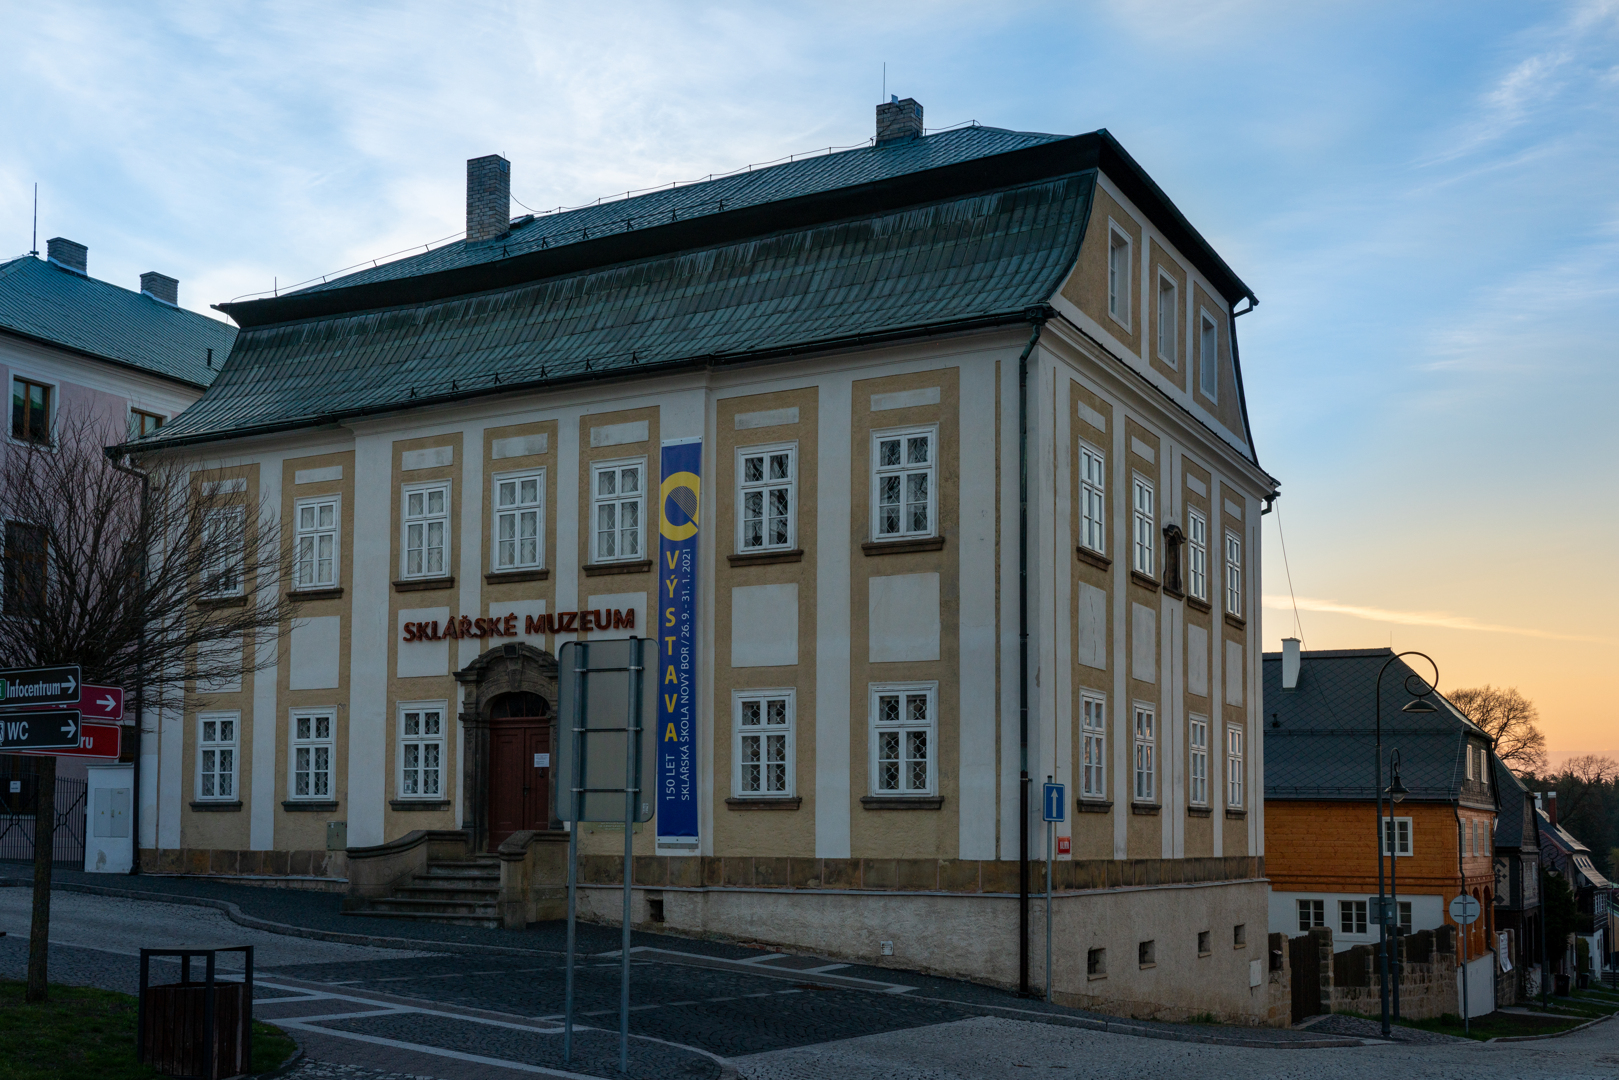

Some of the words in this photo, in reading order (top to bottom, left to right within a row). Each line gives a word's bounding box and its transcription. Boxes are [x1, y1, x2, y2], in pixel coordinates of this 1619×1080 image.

[682, 548, 691, 573] 2021
[403, 613, 517, 641] SKLÁŘSKÉ
[525, 609, 635, 634] MUZEUM
[664, 550, 679, 742] VÝSTAVA
[681, 647, 690, 669] BOR
[7, 679, 60, 698] Infocentrum
[679, 672, 690, 703] NOVÝ
[7, 721, 28, 740] WC
[679, 706, 690, 742] ŠKOLA
[665, 753, 676, 776] LET
[679, 745, 690, 801] SKLÁŘSKÁ
[665, 779, 676, 801] 150
